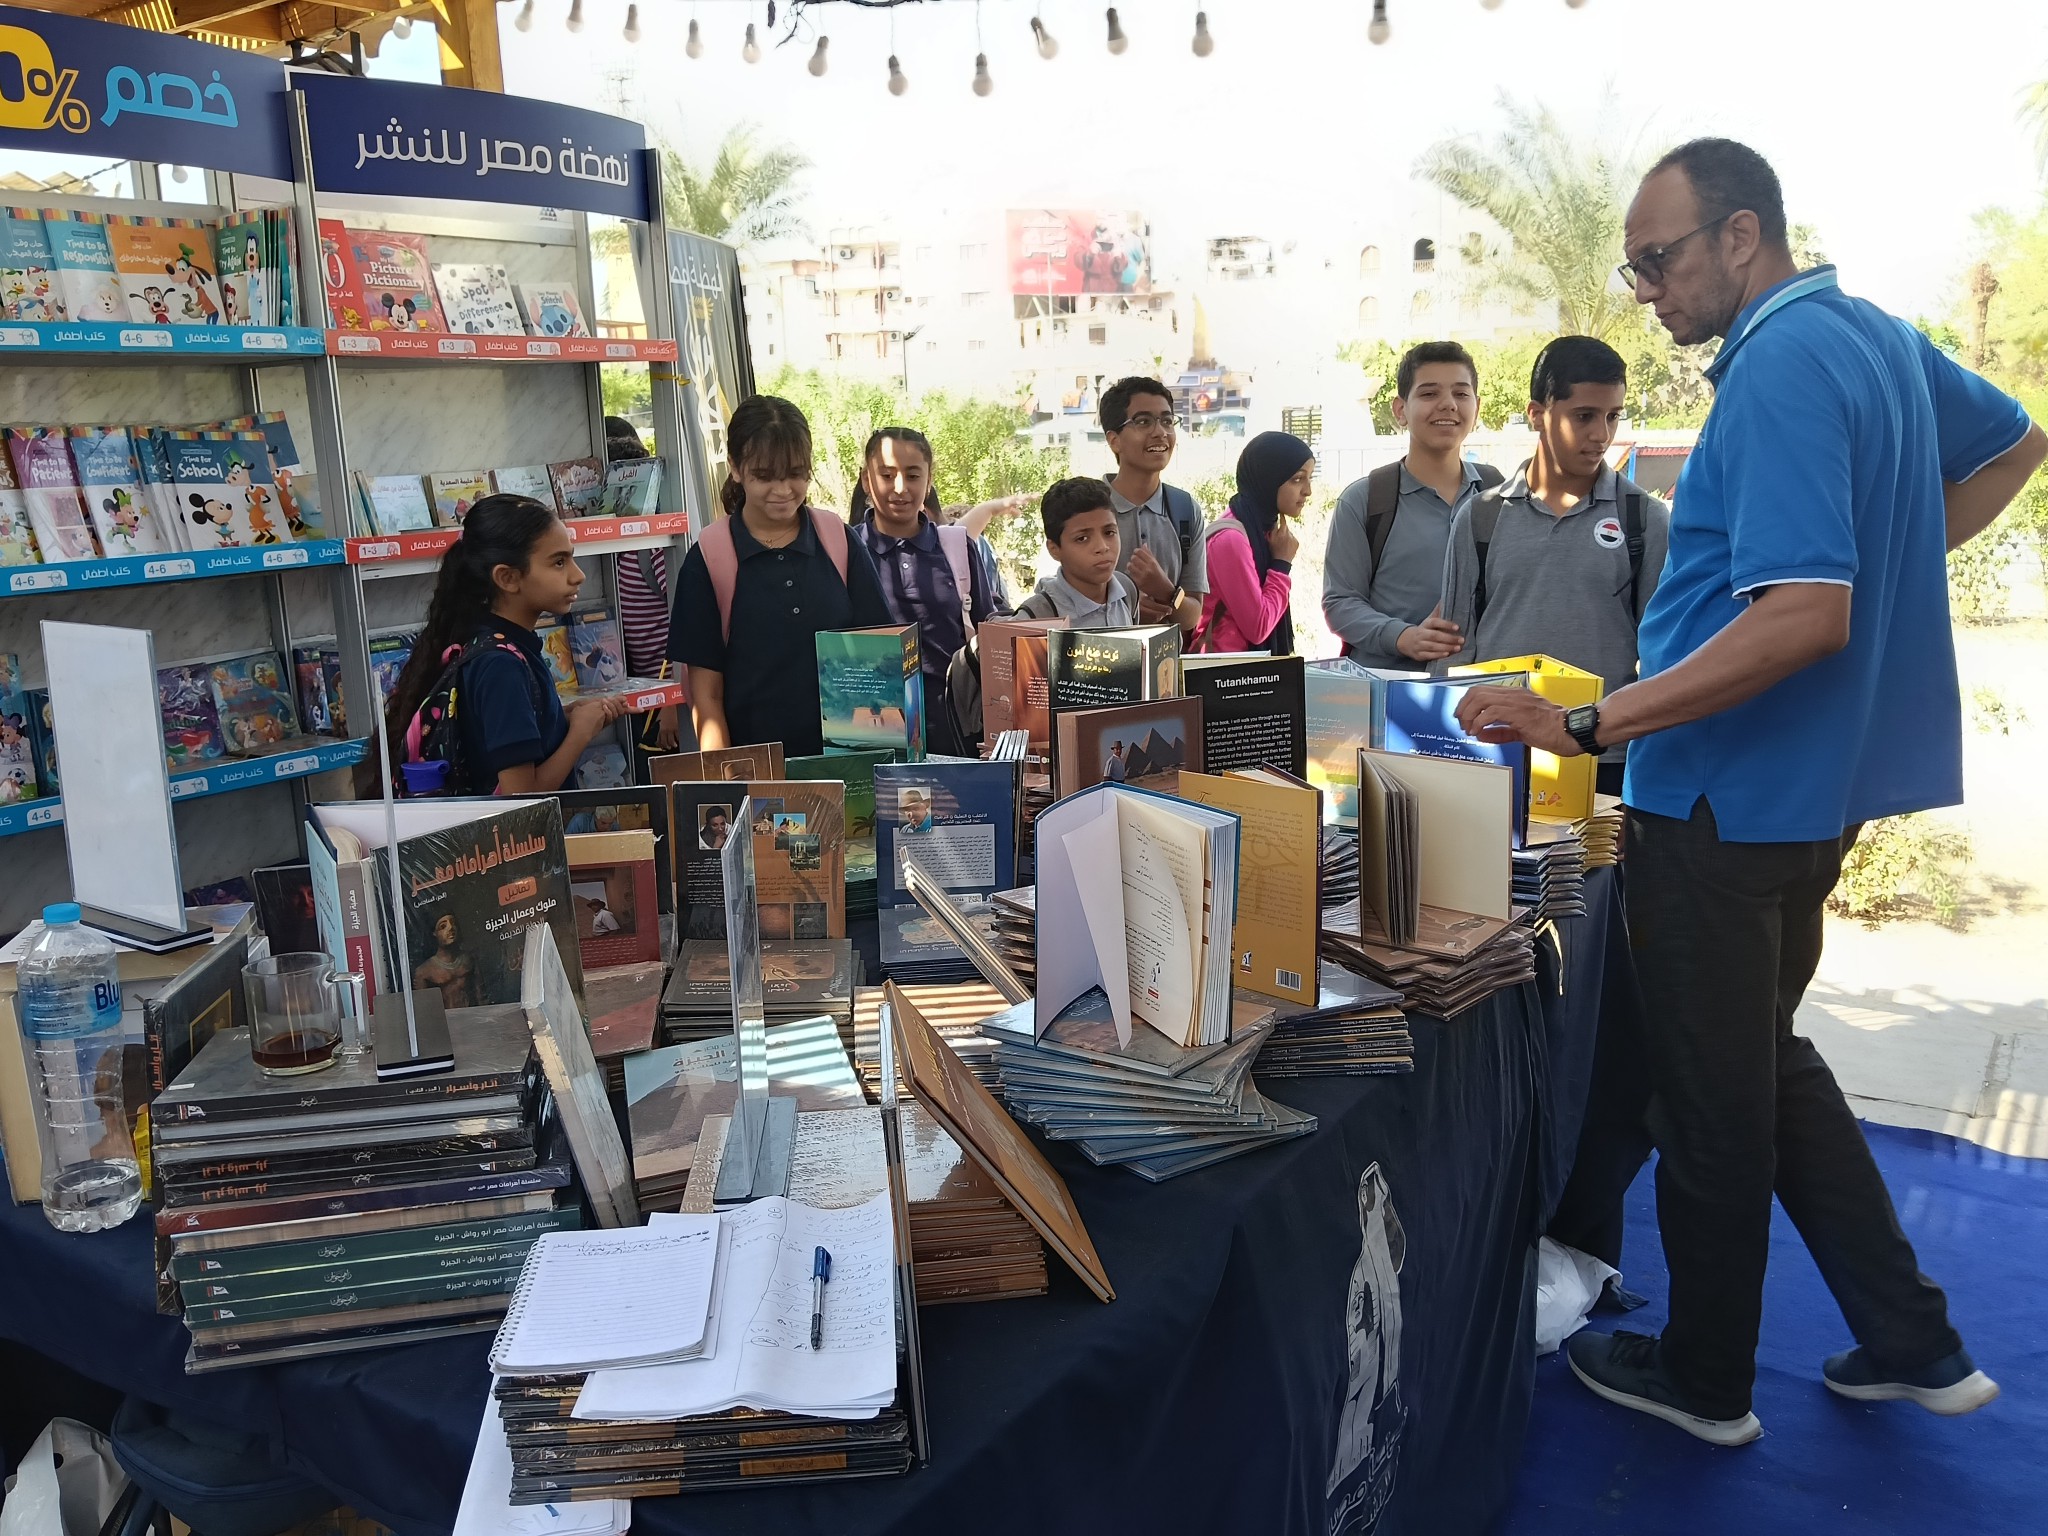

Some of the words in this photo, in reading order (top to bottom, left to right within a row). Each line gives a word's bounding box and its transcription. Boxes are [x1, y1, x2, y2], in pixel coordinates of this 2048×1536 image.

[100, 65, 238, 128] خصم
[354, 116, 467, 170] للنشر
[476, 138, 552, 176] مصر
[559, 137, 629, 187] نهضة
[370, 261, 413, 275] Picture
[363, 273, 425, 290] Dictionary
[461, 284, 489, 300] Spot
[459, 303, 504, 320] Difference
[124, 332, 143, 344] 4-6
[245, 335, 262, 346] 4-6
[342, 339, 357, 349] 1-3
[441, 341, 455, 351] 1-3
[529, 343, 542, 353] 1-3
[183, 456, 198, 464] Time
[200, 455, 212, 464] for
[32, 466, 73, 482] Patient
[86, 464, 131, 478] Confident
[178, 462, 224, 478] School
[618, 469, 638, 481] الفيل
[623, 523, 634, 533] 1-3
[362, 545, 377, 556] 1-3
[266, 552, 283, 563] 4-6
[148, 564, 167, 575] 4-6
[15, 575, 35, 587] 4-6
[1066, 644, 1085, 658] آمون
[1086, 646, 1101, 661] عنخ
[1102, 649, 1119, 662] توت
[1215, 674, 1280, 688] Tutankhamun
[278, 762, 295, 773] 4-6
[170, 784, 180, 795] -6
[32, 809, 51, 821] 4-6
[456, 825, 502, 878] أهرامات
[503, 833, 546, 863] سلسلة
[535, 897, 557, 913] ملوك
[510, 907, 535, 924] وعمال
[485, 913, 509, 933] الجيزة
[673, 1049, 726, 1067] الجيزة
[486, 1181, 498, 1191] مصر
[499, 1179, 520, 1189] أهرامات
[521, 1178, 541, 1186] سلسلة
[508, 1222, 535, 1233] أهرامات
[537, 1220, 560, 1229] سلسلة
[434, 1232, 455, 1242] الجيزة
[461, 1230, 480, 1240] رواش
[480, 1228, 491, 1238] أبو
[493, 1227, 507, 1236] مصر
[440, 1257, 461, 1267] الجيزة
[466, 1255, 486, 1265] رواش
[486, 1253, 497, 1263] أبو
[498, 1252, 513, 1261] مصر
[446, 1281, 466, 1290] الجيزة
[472, 1278, 491, 1288] رواش
[492, 1276, 503, 1286] أبو
[504, 1276, 518, 1285] مصر
